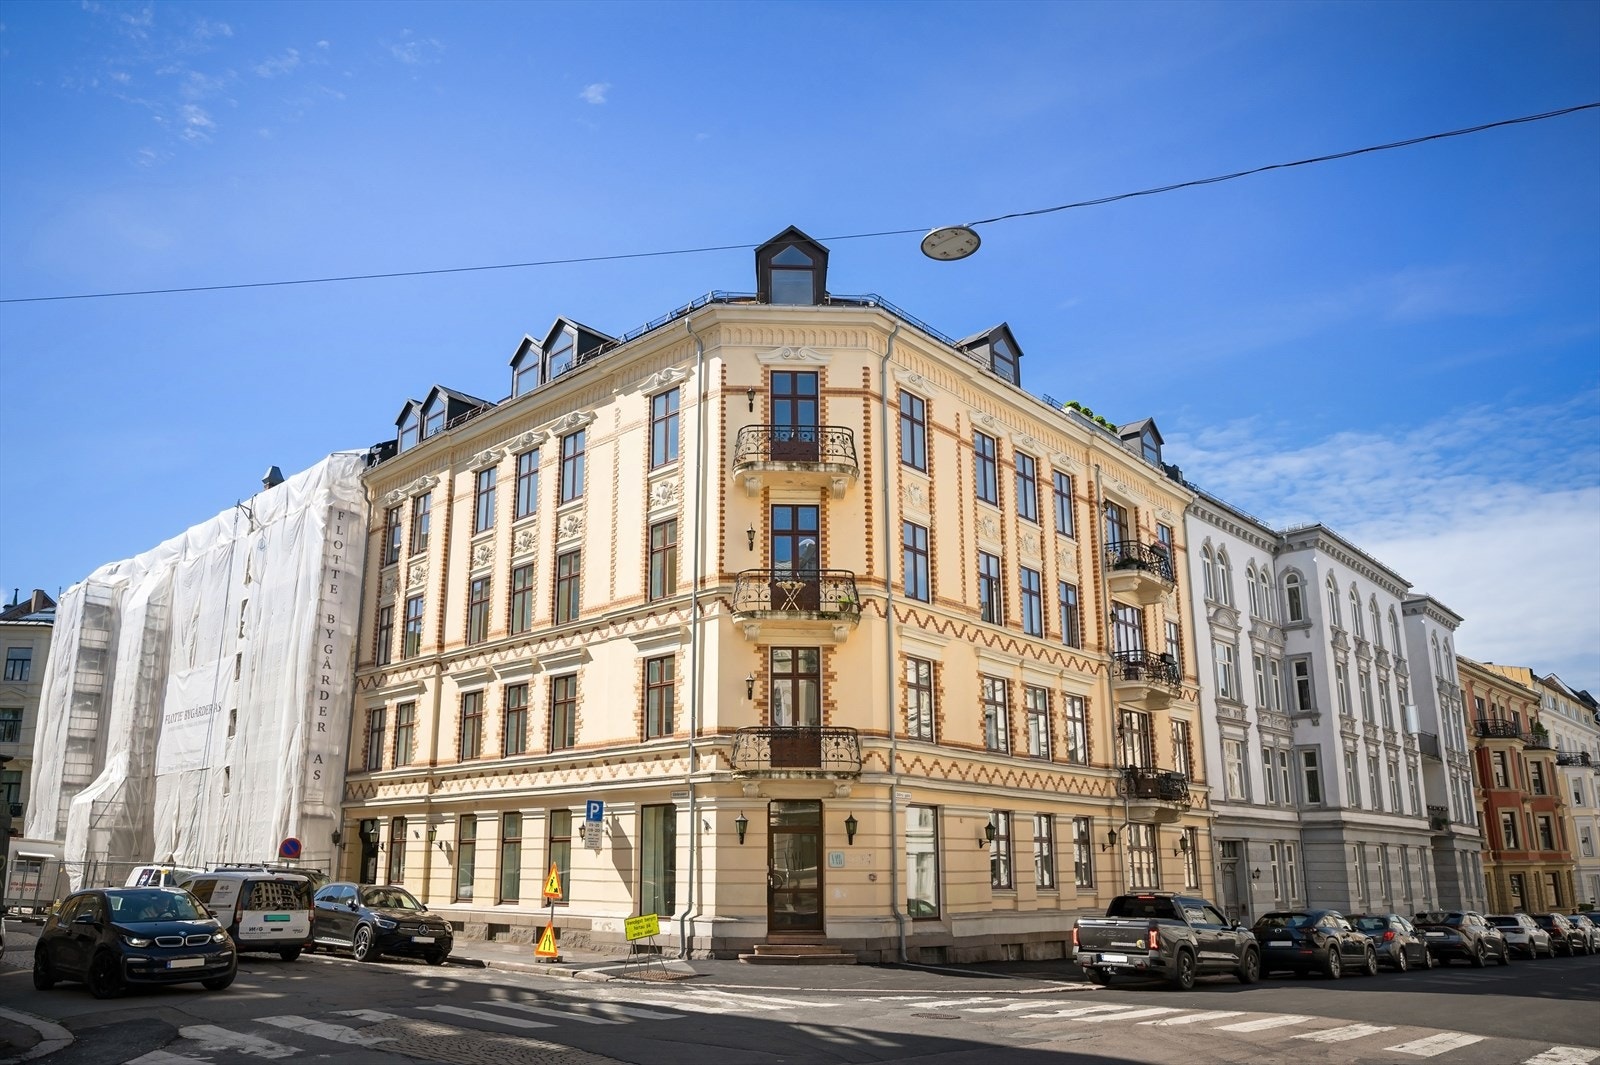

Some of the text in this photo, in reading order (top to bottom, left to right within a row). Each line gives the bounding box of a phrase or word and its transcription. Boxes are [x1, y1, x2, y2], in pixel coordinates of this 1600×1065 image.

[329, 511, 345, 595] FLOTTE
[317, 613, 336, 733] BYGÅRDER
[312, 753, 324, 781] AS
[590, 802, 600, 819] P
